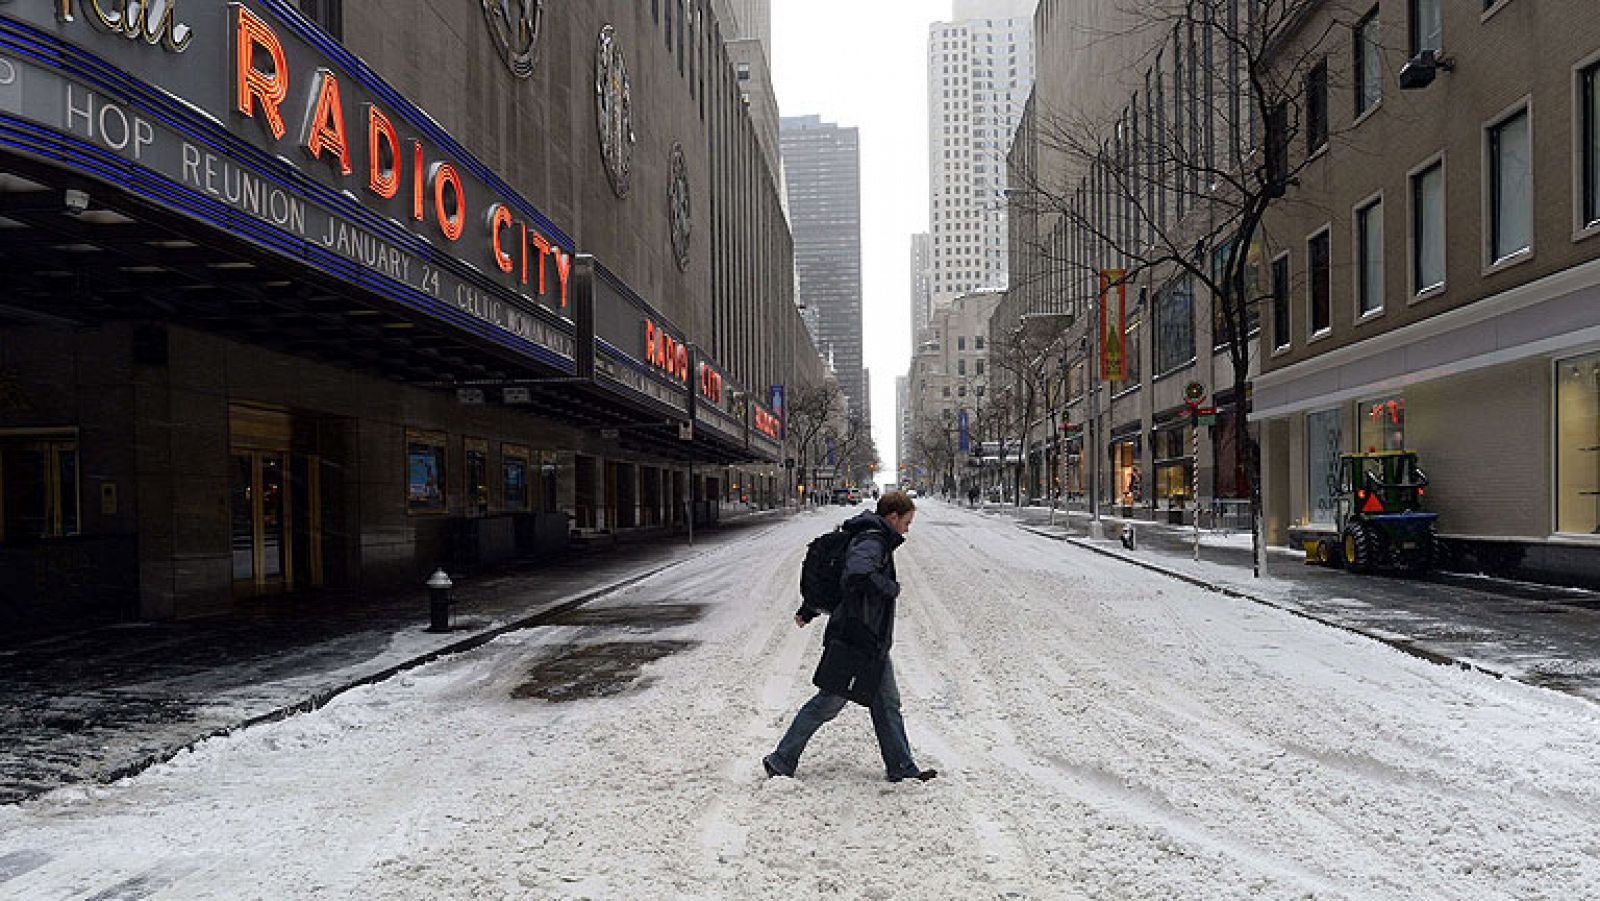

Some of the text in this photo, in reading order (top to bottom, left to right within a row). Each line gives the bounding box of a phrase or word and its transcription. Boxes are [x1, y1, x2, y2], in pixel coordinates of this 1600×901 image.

[66, 83, 153, 159] HOP
[182, 142, 305, 235] REUNION
[322, 216, 411, 281] JANUARY
[421, 264, 440, 296] 24
[235, 4, 571, 308] RADIO CITY
